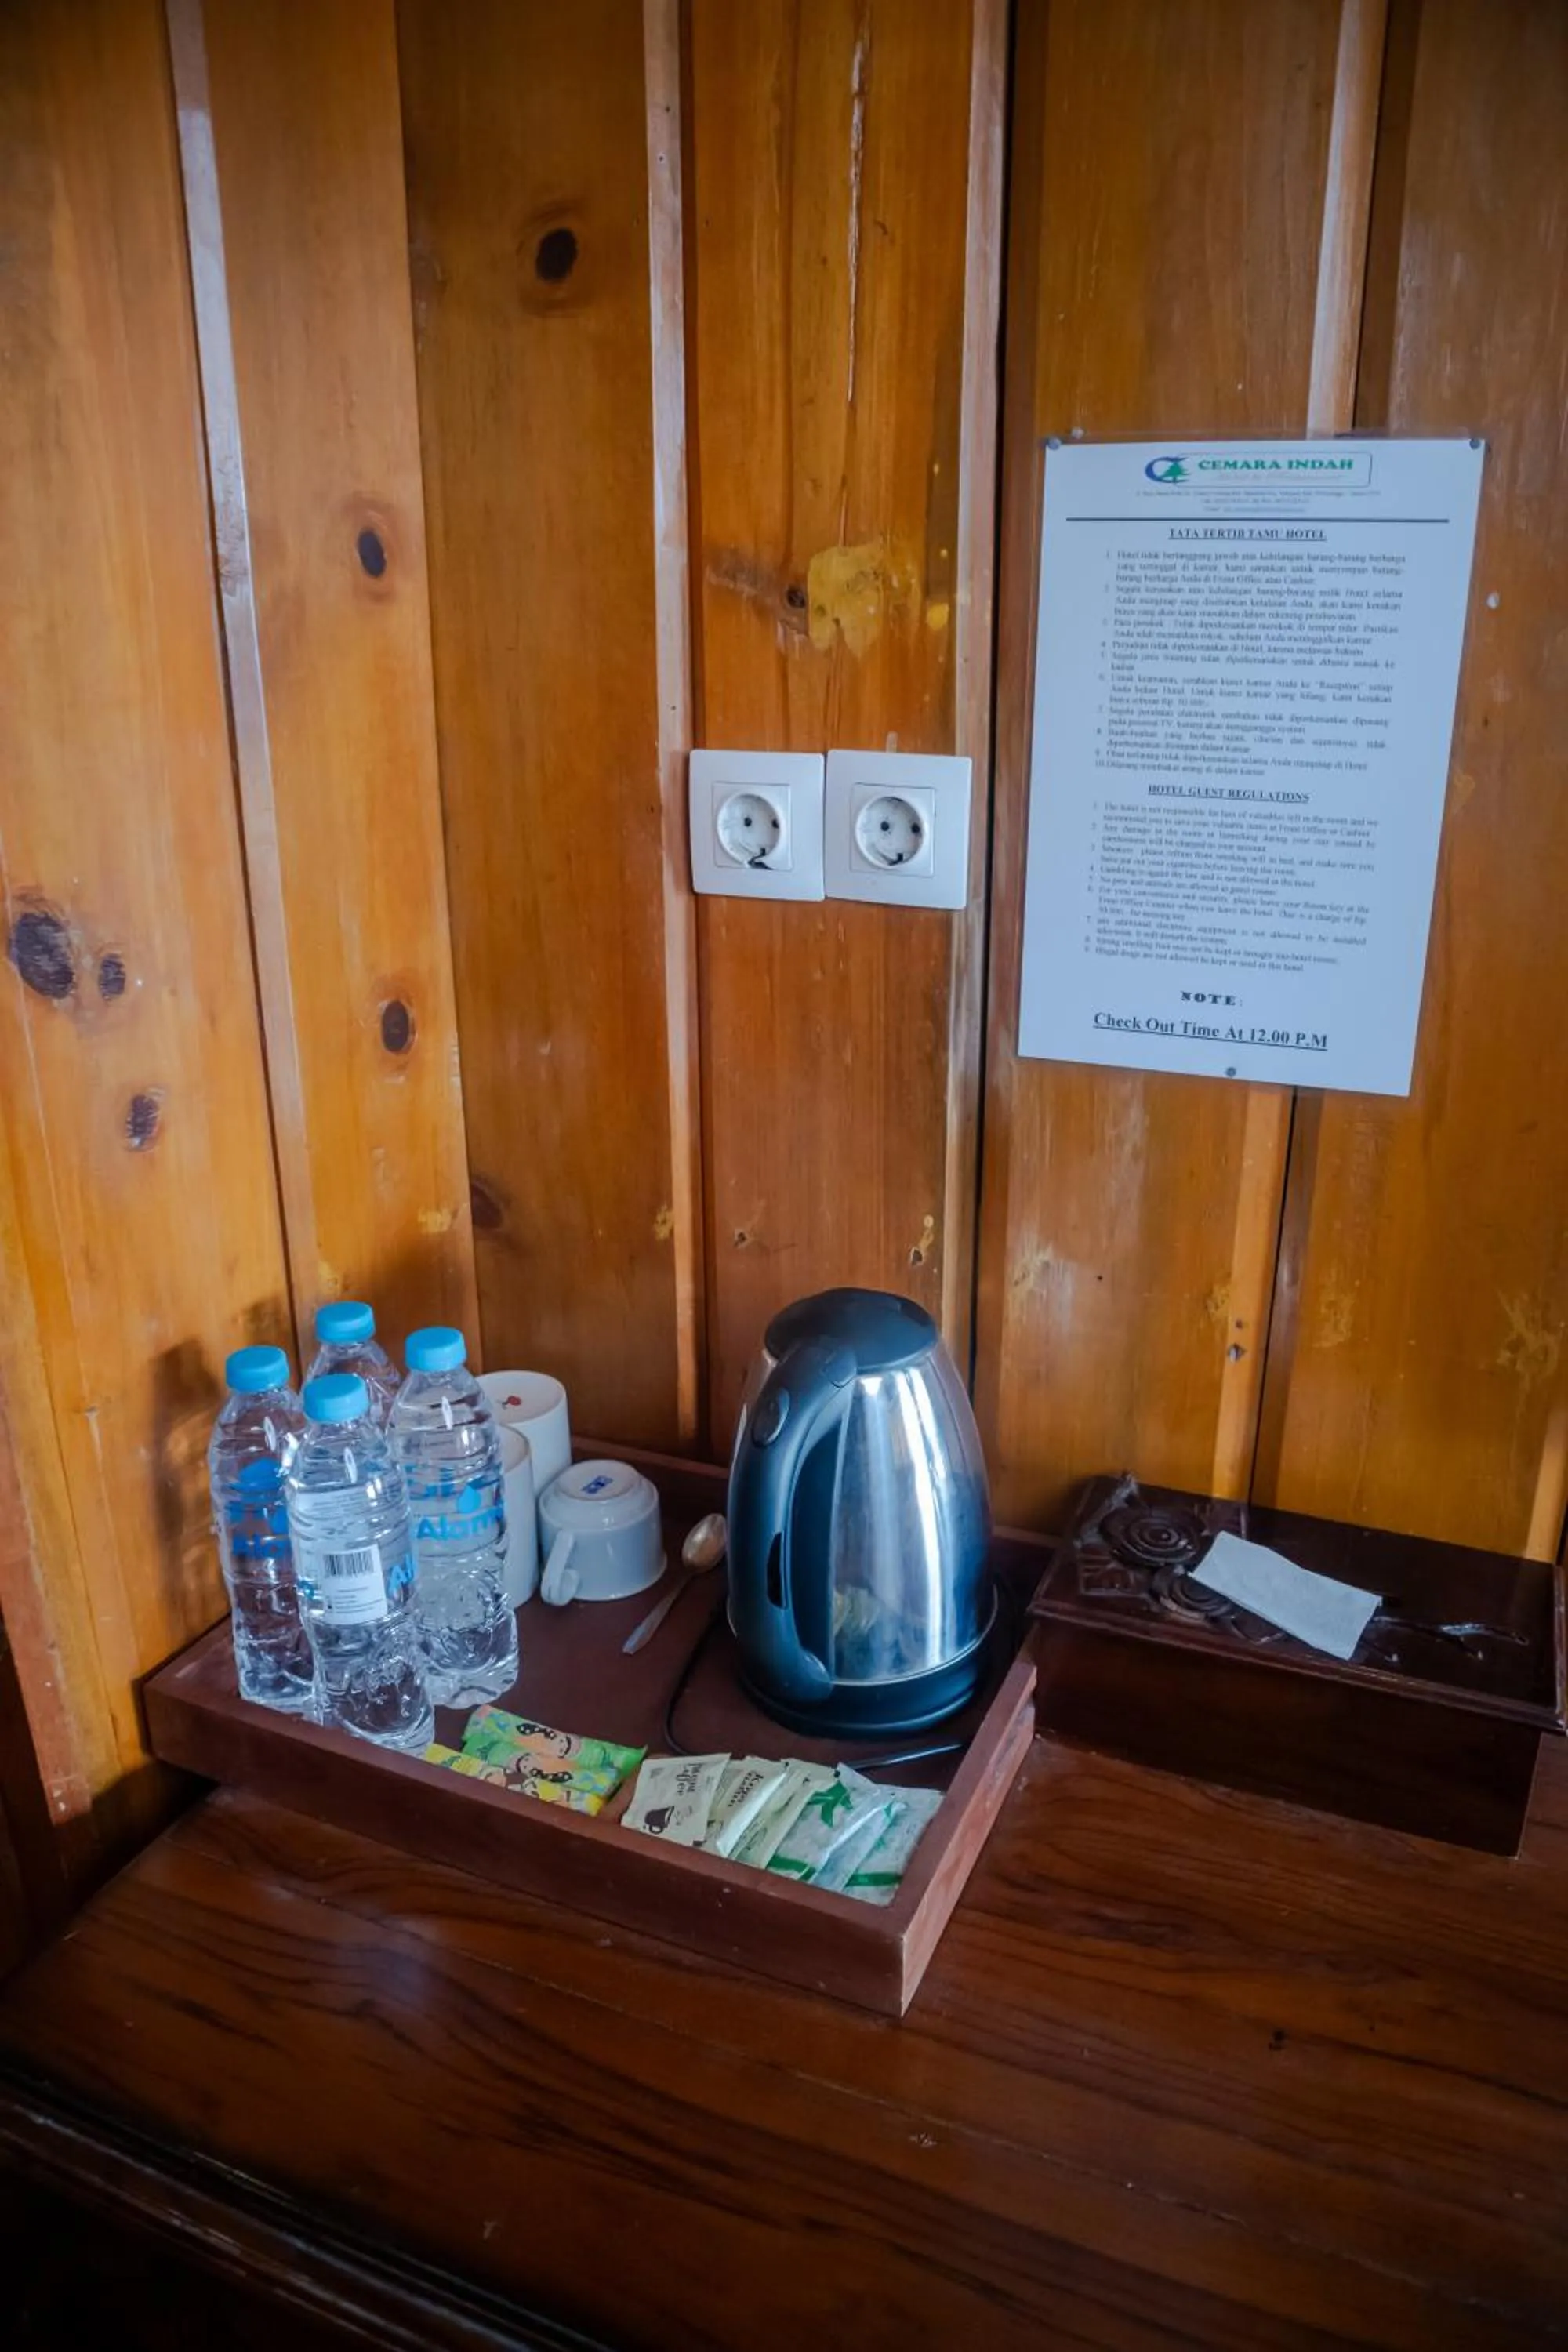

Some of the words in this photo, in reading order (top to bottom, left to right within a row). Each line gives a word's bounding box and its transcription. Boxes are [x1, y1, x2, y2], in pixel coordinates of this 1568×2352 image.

[1198, 459, 1282, 470] CEMARA
[1287, 459, 1354, 470] INDAH
[1169, 528, 1199, 539] TATA
[1202, 528, 1247, 539] TERTIB
[1285, 528, 1327, 541] HOTEL
[1149, 784, 1184, 797] HOTEL
[1187, 786, 1223, 798] GUEST
[1227, 787, 1310, 803] REGULATIONS
[1093, 1011, 1142, 1029] Check
[1145, 1017, 1175, 1033] Out
[1179, 1020, 1220, 1037] Time
[1225, 1025, 1243, 1040] At
[1249, 1027, 1290, 1044] 12.00
[1294, 1032, 1328, 1048] P.M
